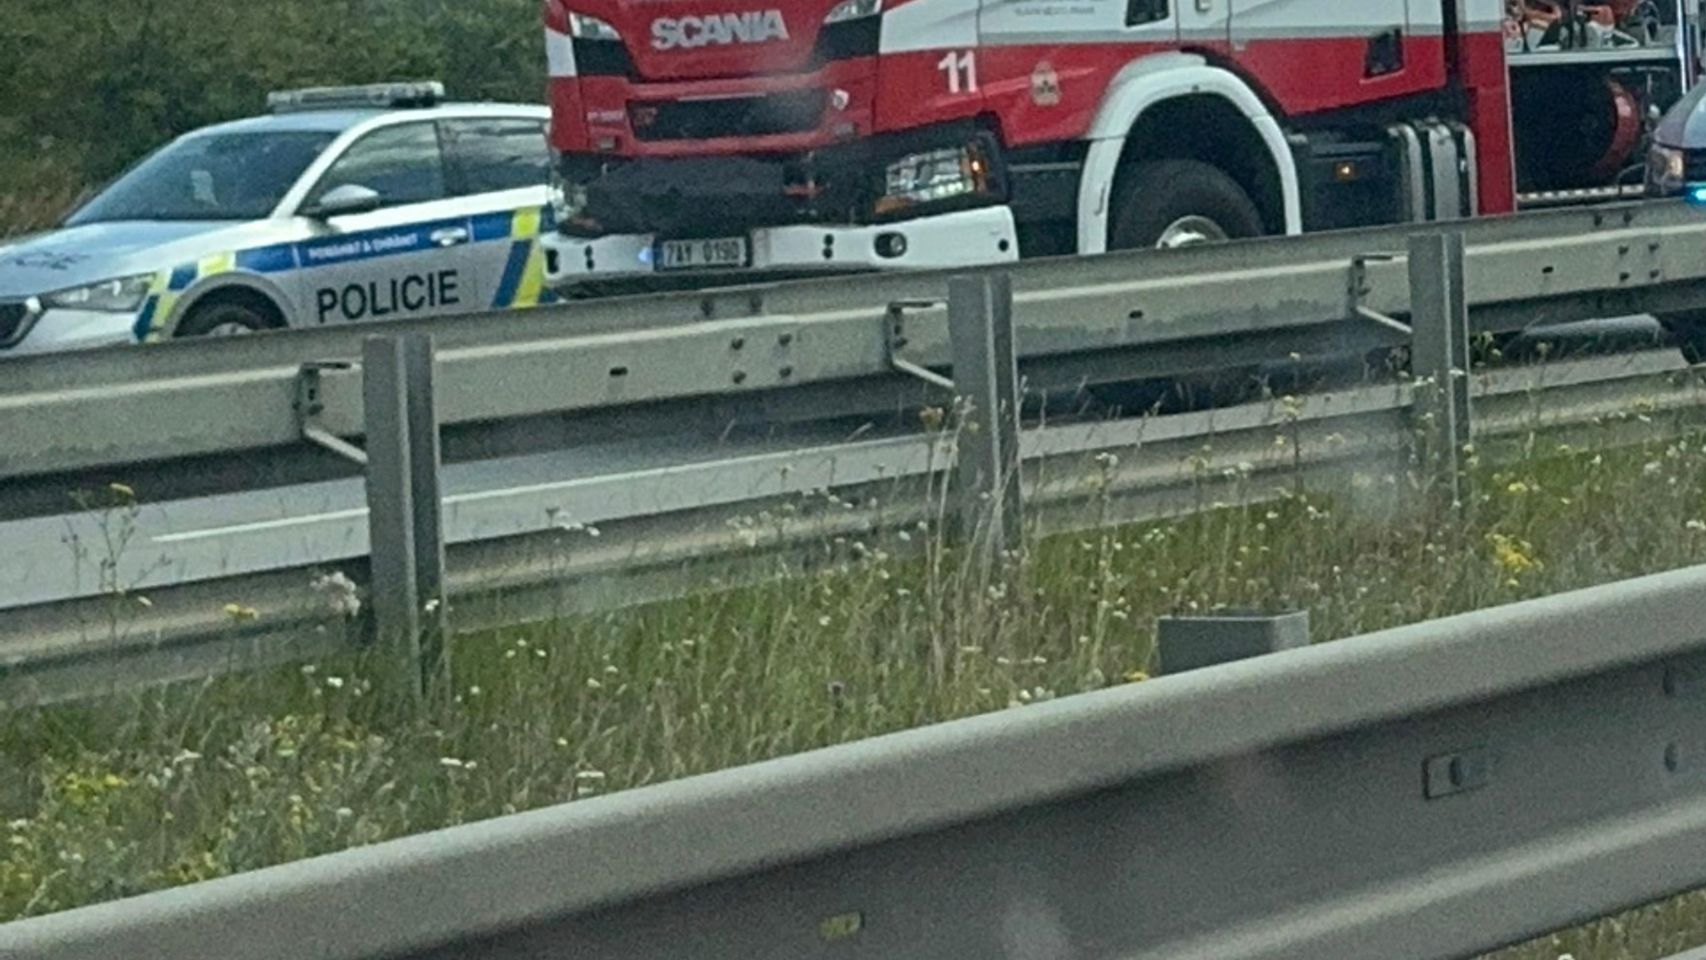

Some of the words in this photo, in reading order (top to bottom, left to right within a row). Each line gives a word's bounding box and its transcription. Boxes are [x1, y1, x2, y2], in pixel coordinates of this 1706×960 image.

[651, 9, 789, 50] SCANIA
[938, 50, 976, 93] 11
[316, 269, 460, 324] POLICIE
